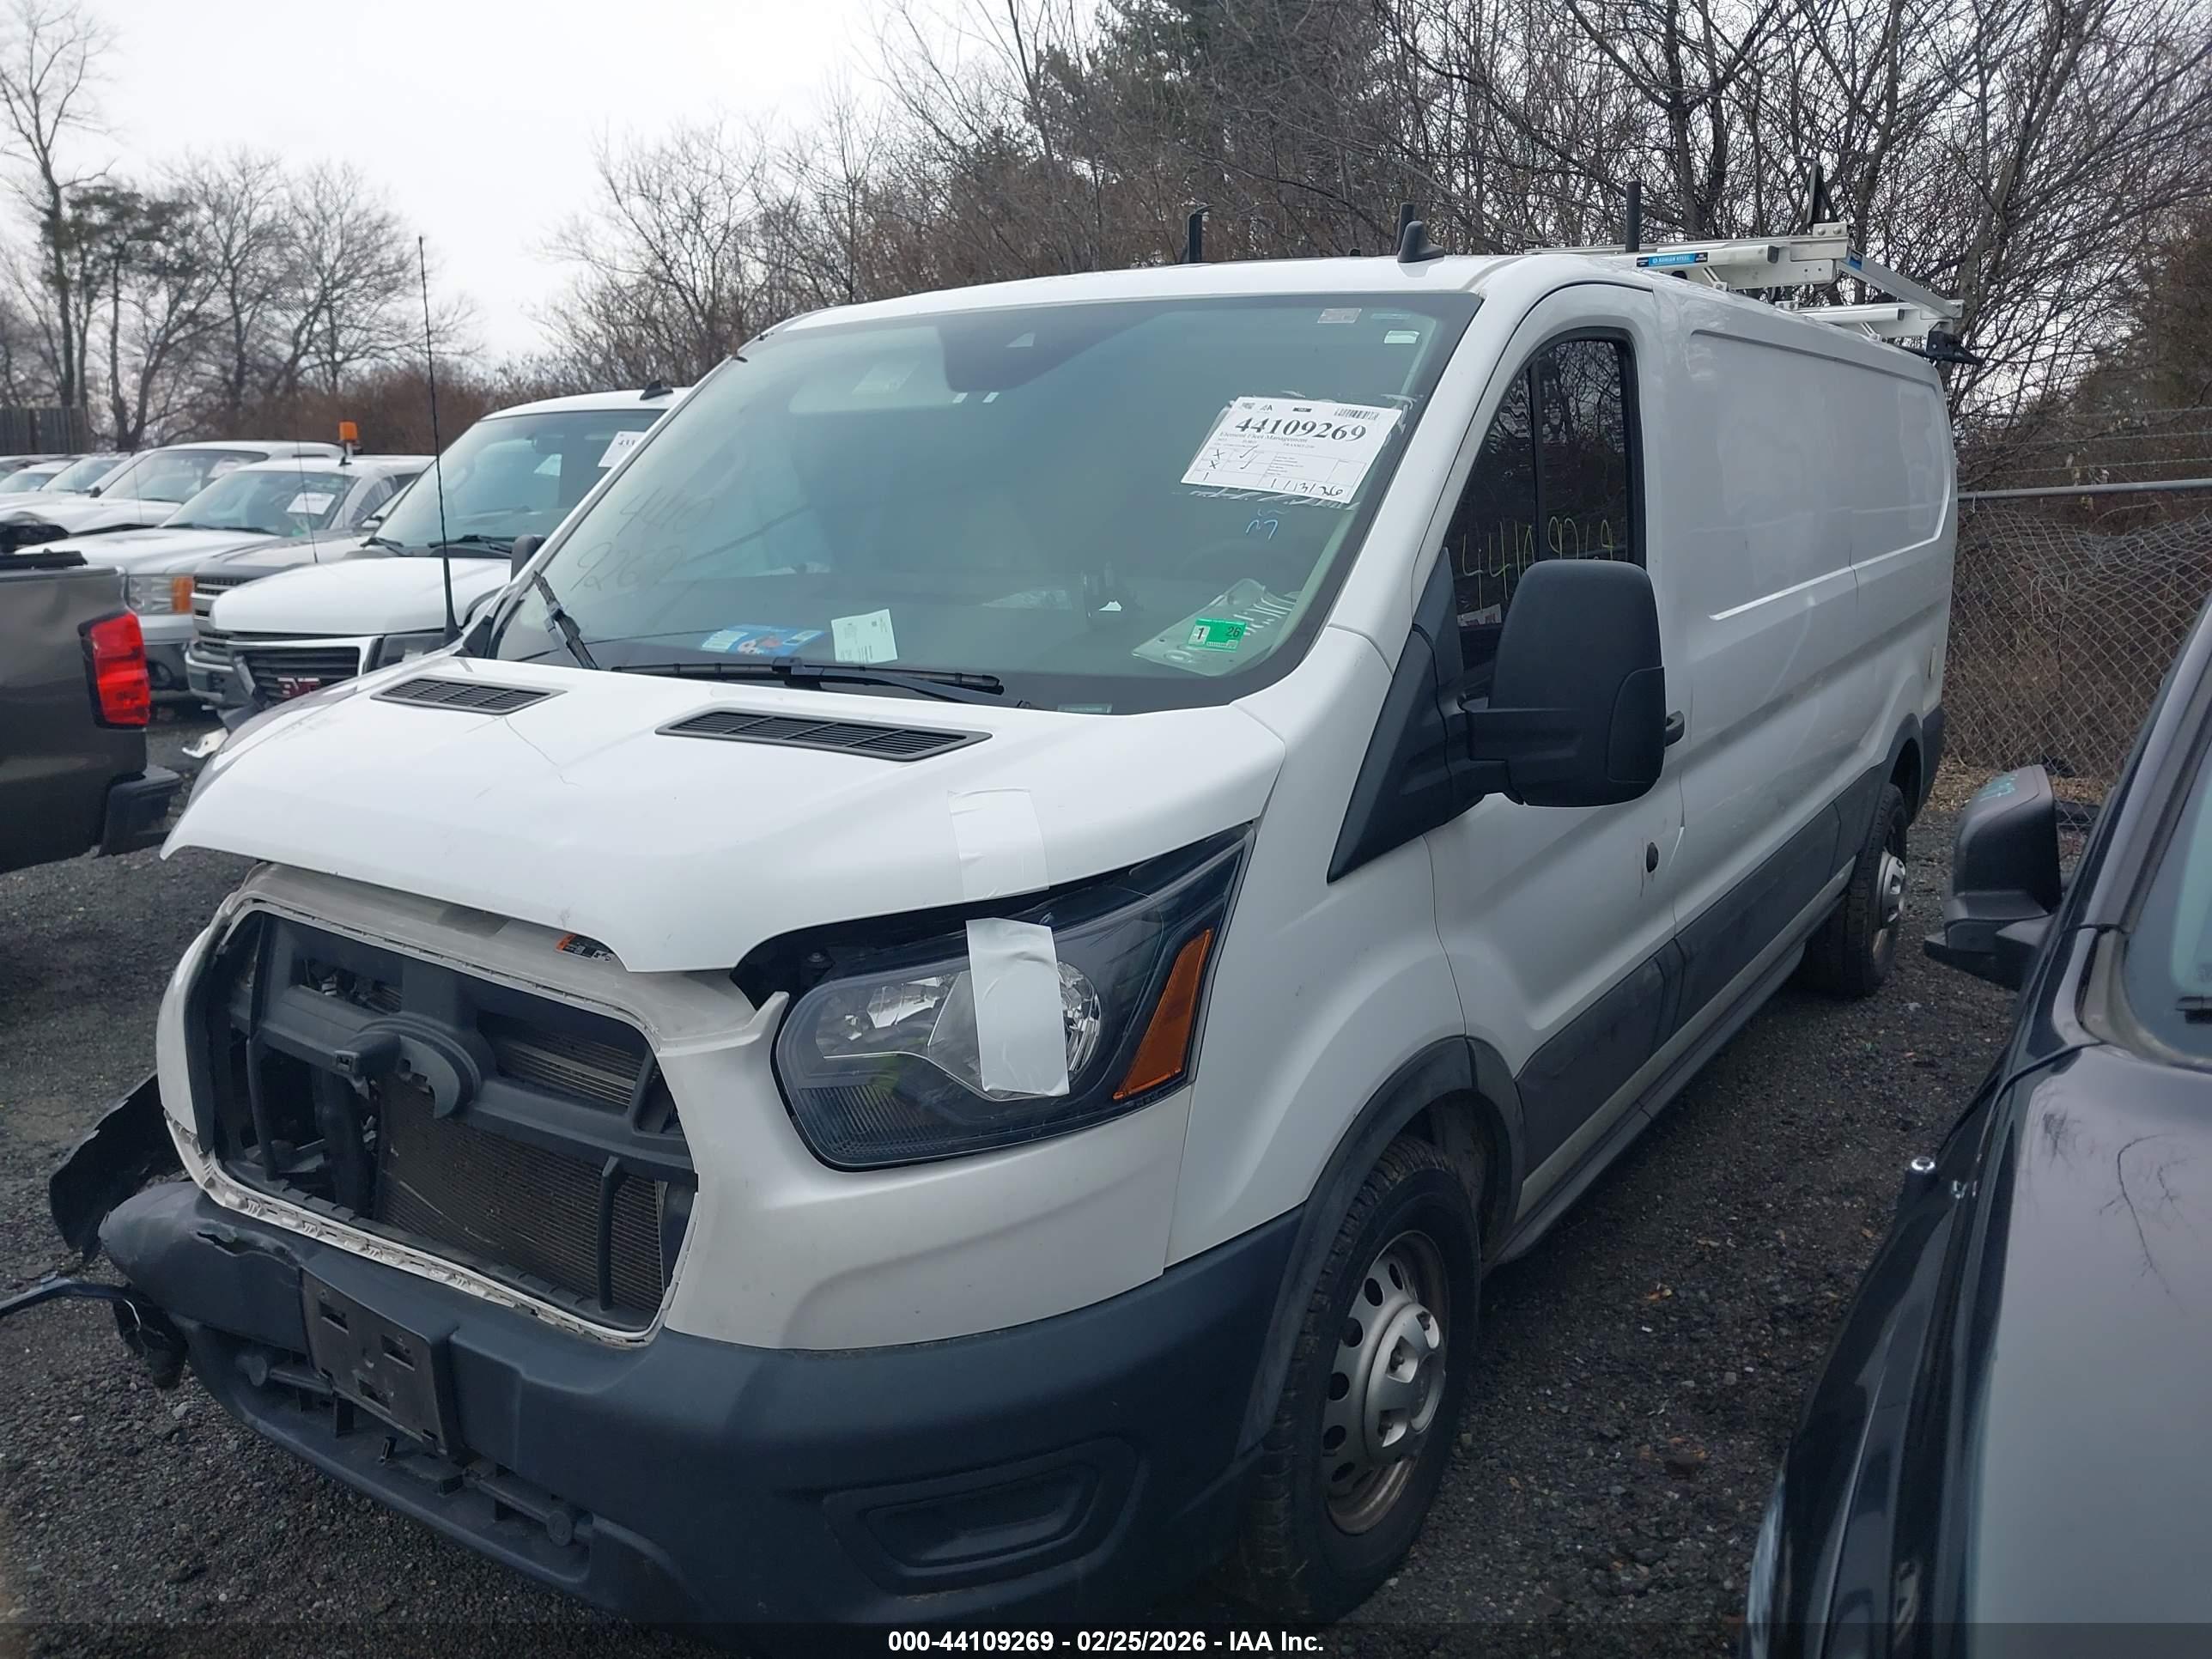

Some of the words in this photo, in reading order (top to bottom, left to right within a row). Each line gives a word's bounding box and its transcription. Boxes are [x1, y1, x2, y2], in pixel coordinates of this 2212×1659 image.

[1235, 416, 1367, 441] 44109269
[1196, 627, 1205, 640] 1
[1225, 625, 1242, 638] 26
